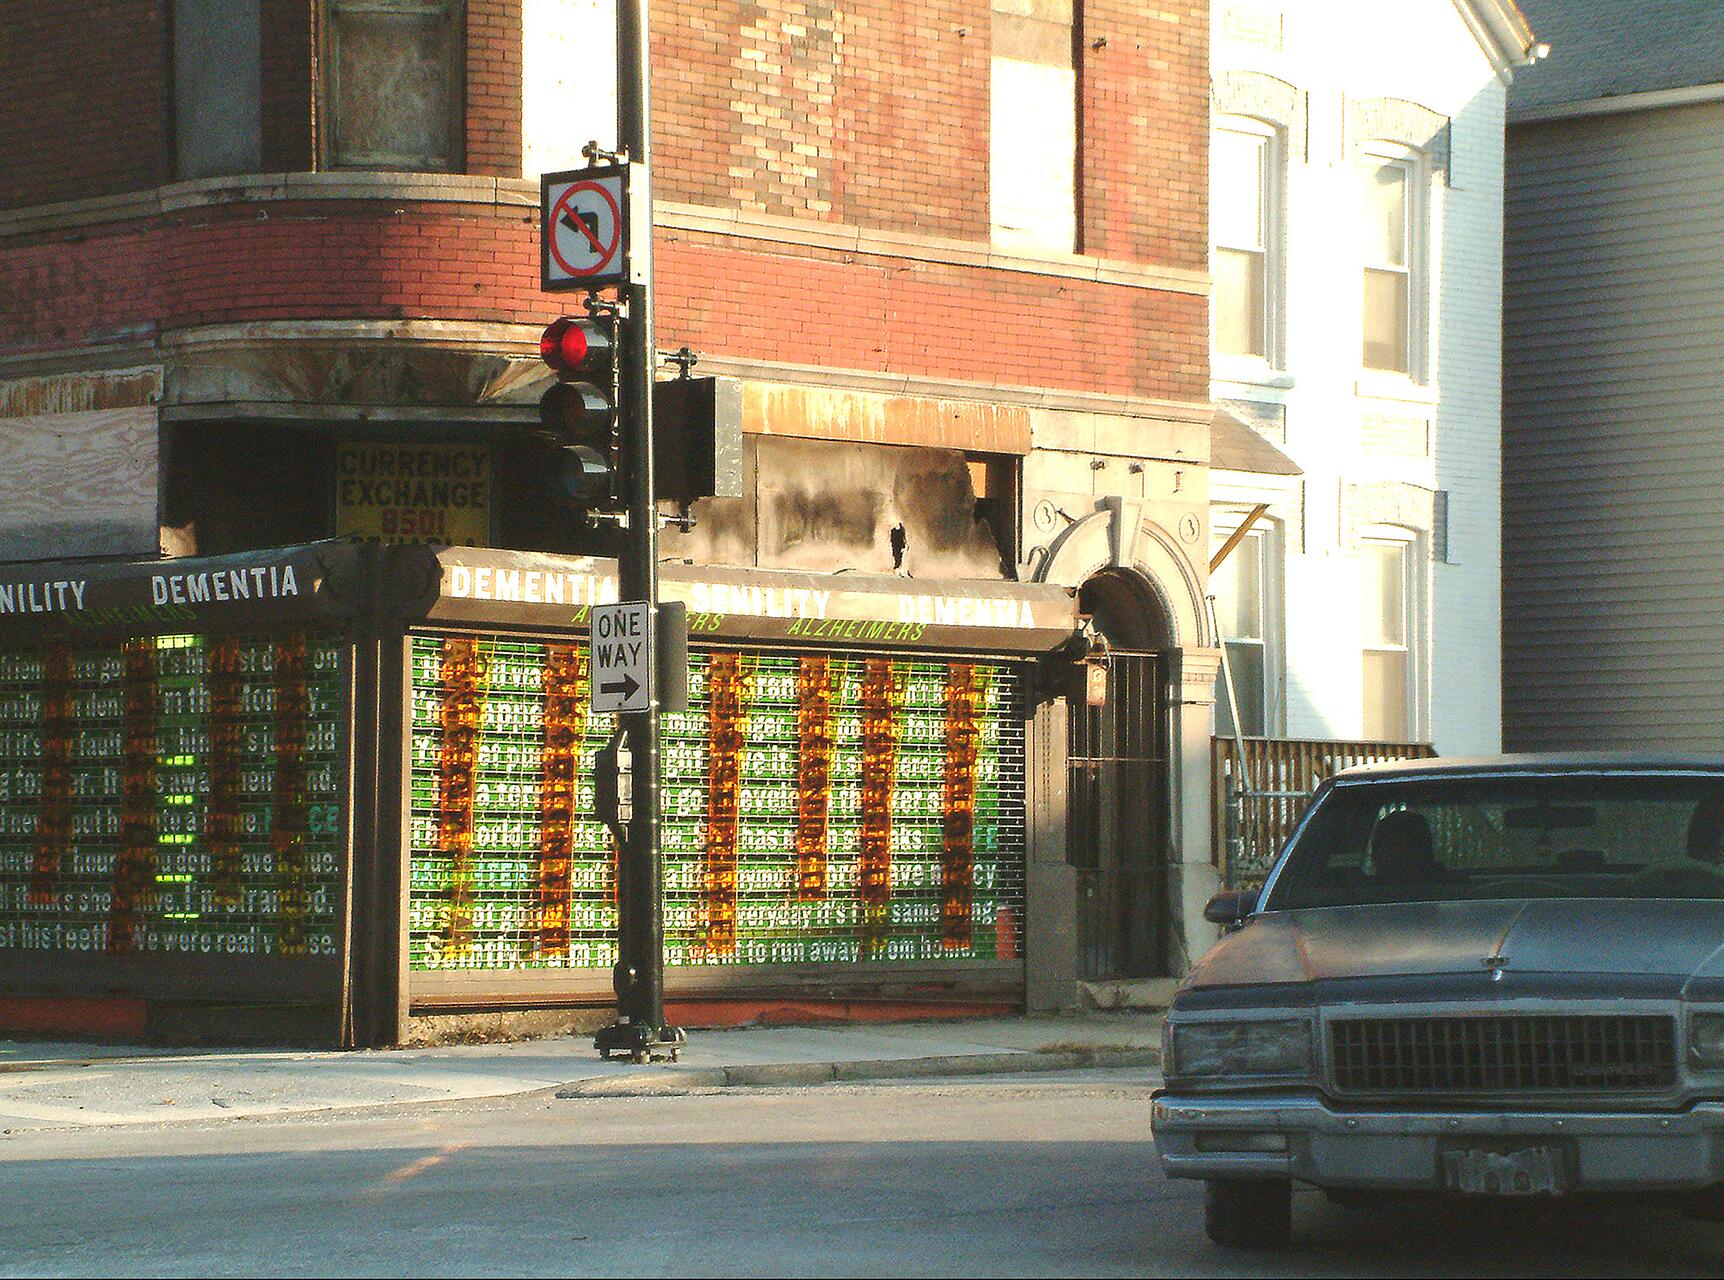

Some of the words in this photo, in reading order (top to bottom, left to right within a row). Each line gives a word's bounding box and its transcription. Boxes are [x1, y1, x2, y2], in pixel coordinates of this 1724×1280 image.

[340, 448, 489, 476] CURRENCY
[341, 479, 486, 508] EXCHANGE
[152, 565, 298, 605] DEMENTIA
[449, 566, 619, 605] DEMENTIA
[692, 581, 830, 620] SENILITY
[898, 594, 1036, 629] DEMENTIA
[598, 612, 642, 639] ONE
[787, 615, 928, 643] ALZHEIMERS
[598, 642, 643, 669] WAY
[575, 902, 596, 928] to
[891, 903, 941, 924] same
[23, 919, 50, 949] his
[748, 940, 768, 964] to
[771, 941, 804, 963] run
[809, 940, 861, 962] away
